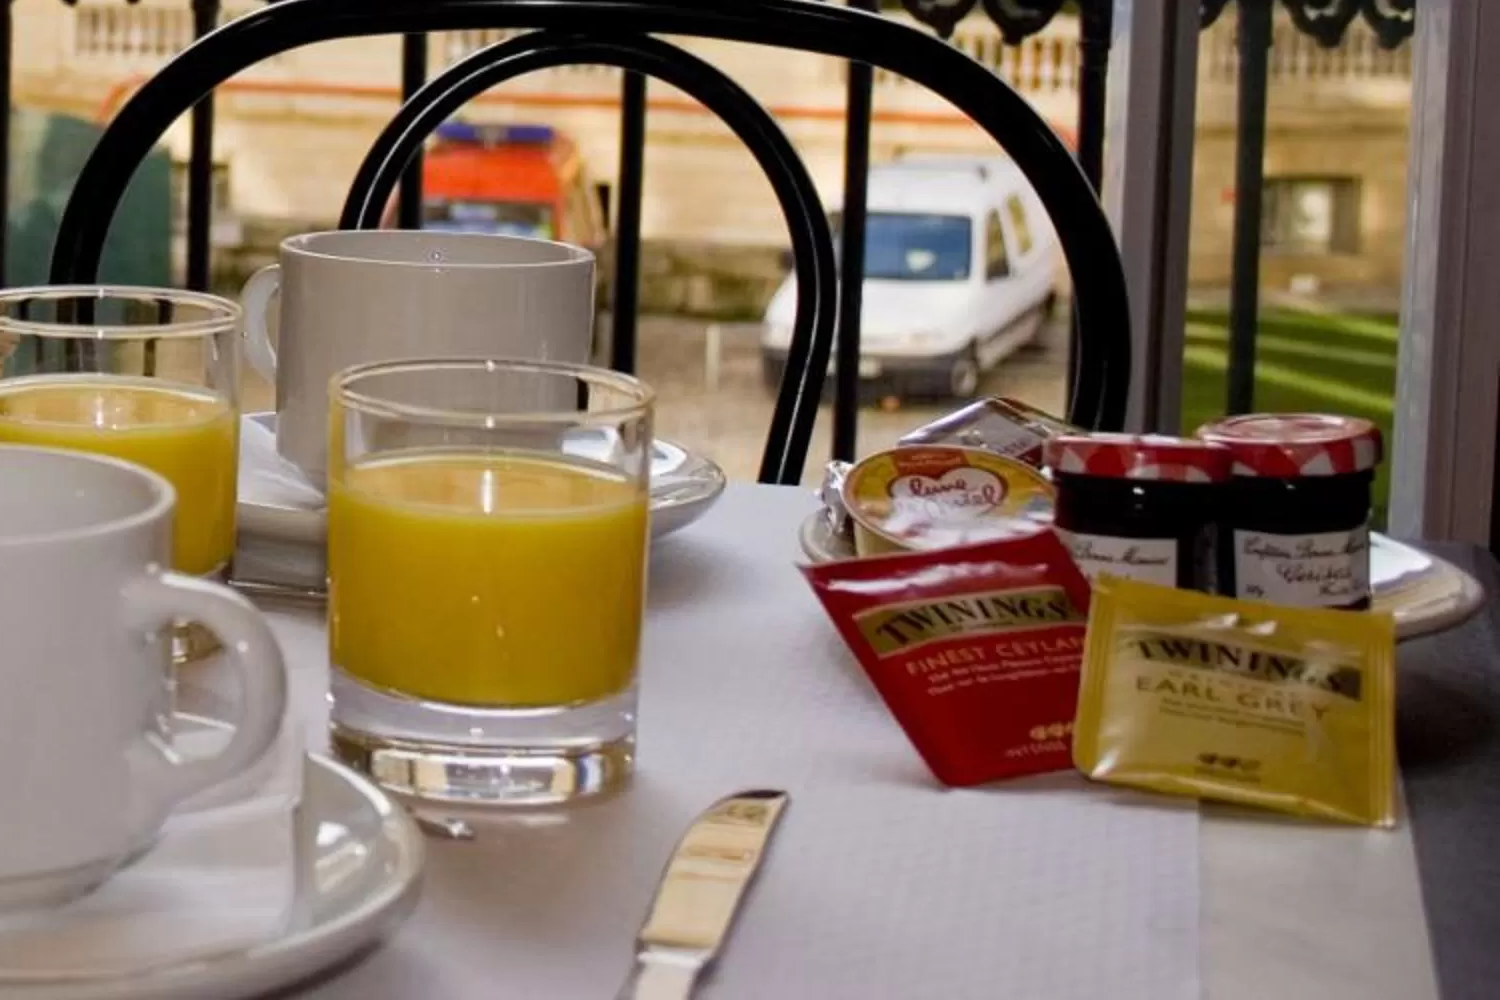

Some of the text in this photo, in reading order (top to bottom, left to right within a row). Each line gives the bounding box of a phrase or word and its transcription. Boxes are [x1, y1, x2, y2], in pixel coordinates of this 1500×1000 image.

[875, 597, 1068, 646] TWININGS
[905, 646, 986, 676] FINEST
[1135, 675, 1221, 702] EARL
